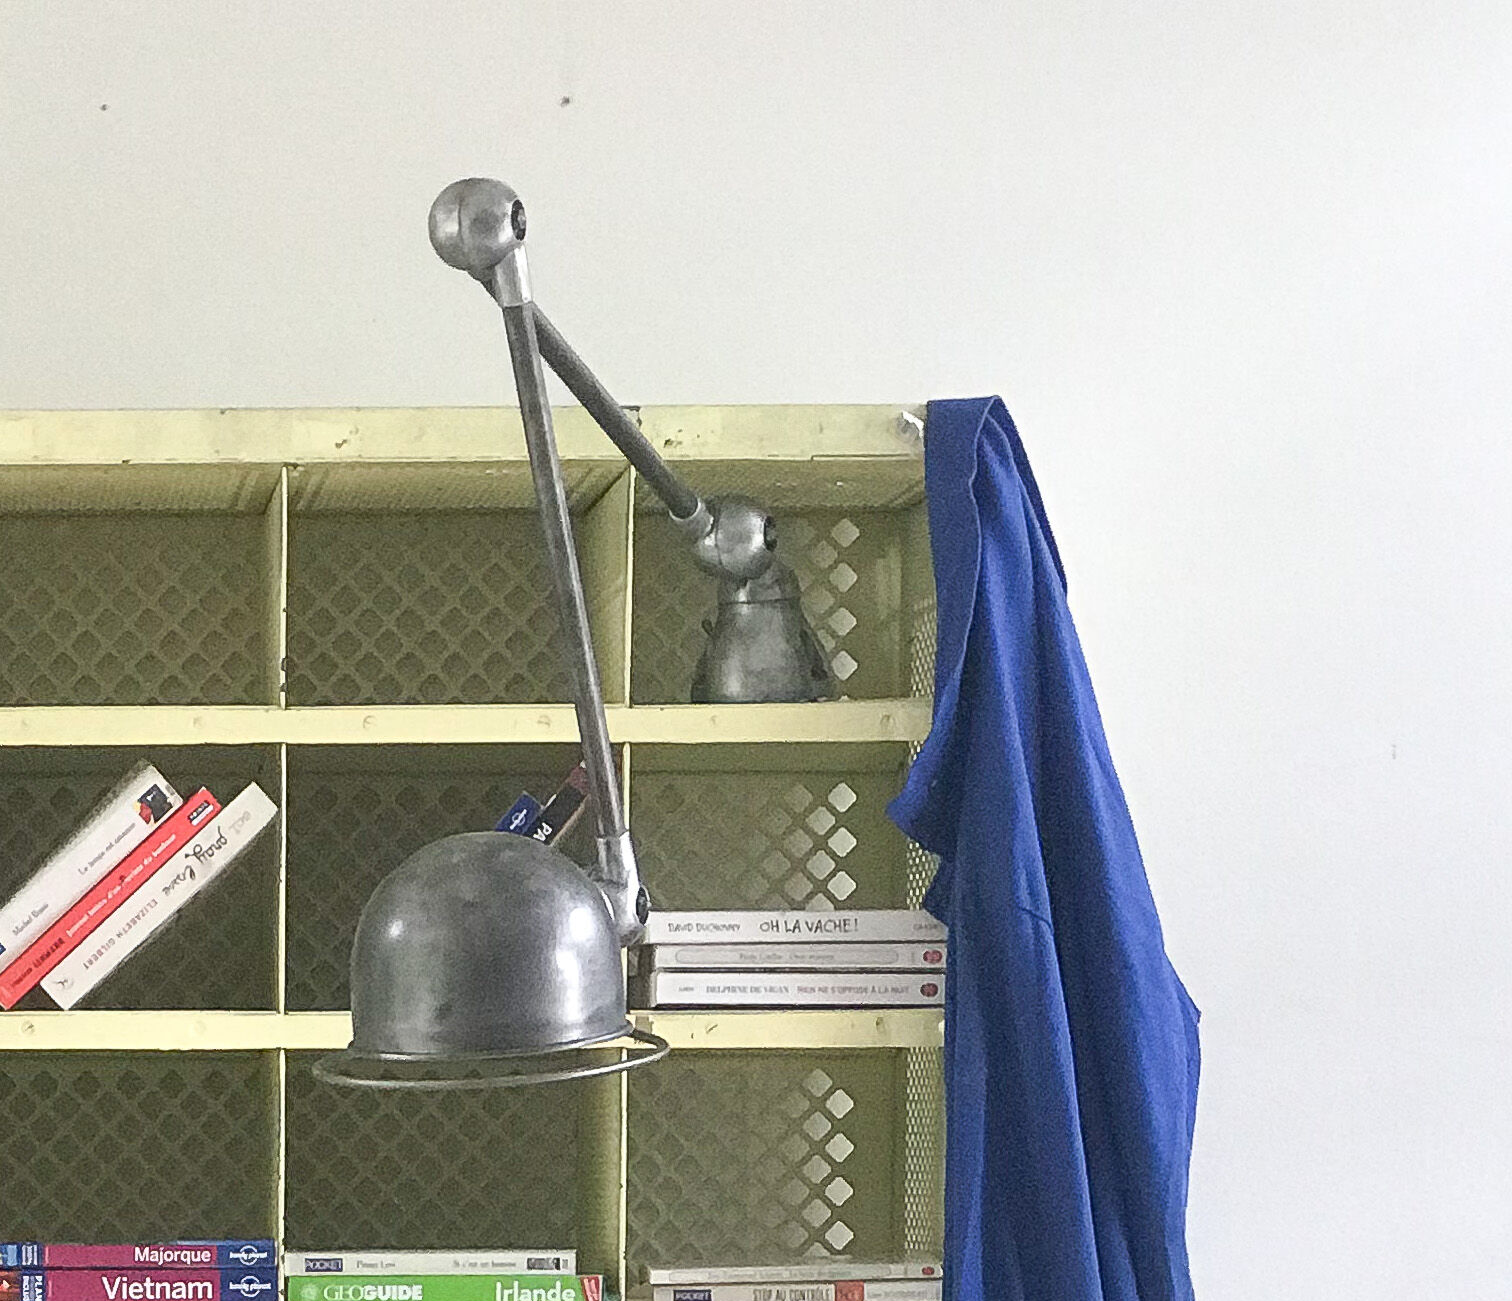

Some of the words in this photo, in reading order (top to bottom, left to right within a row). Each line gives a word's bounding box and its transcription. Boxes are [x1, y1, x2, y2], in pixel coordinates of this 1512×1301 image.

[184, 825, 228, 865] pray
[161, 864, 196, 895] love
[115, 898, 158, 939] ELIZABETH
[759, 919, 780, 934] OH
[784, 919, 802, 934] LA
[82, 937, 116, 970] GILBERT
[134, 1246, 212, 1265] Majorque
[101, 1275, 214, 1301] Vietnam
